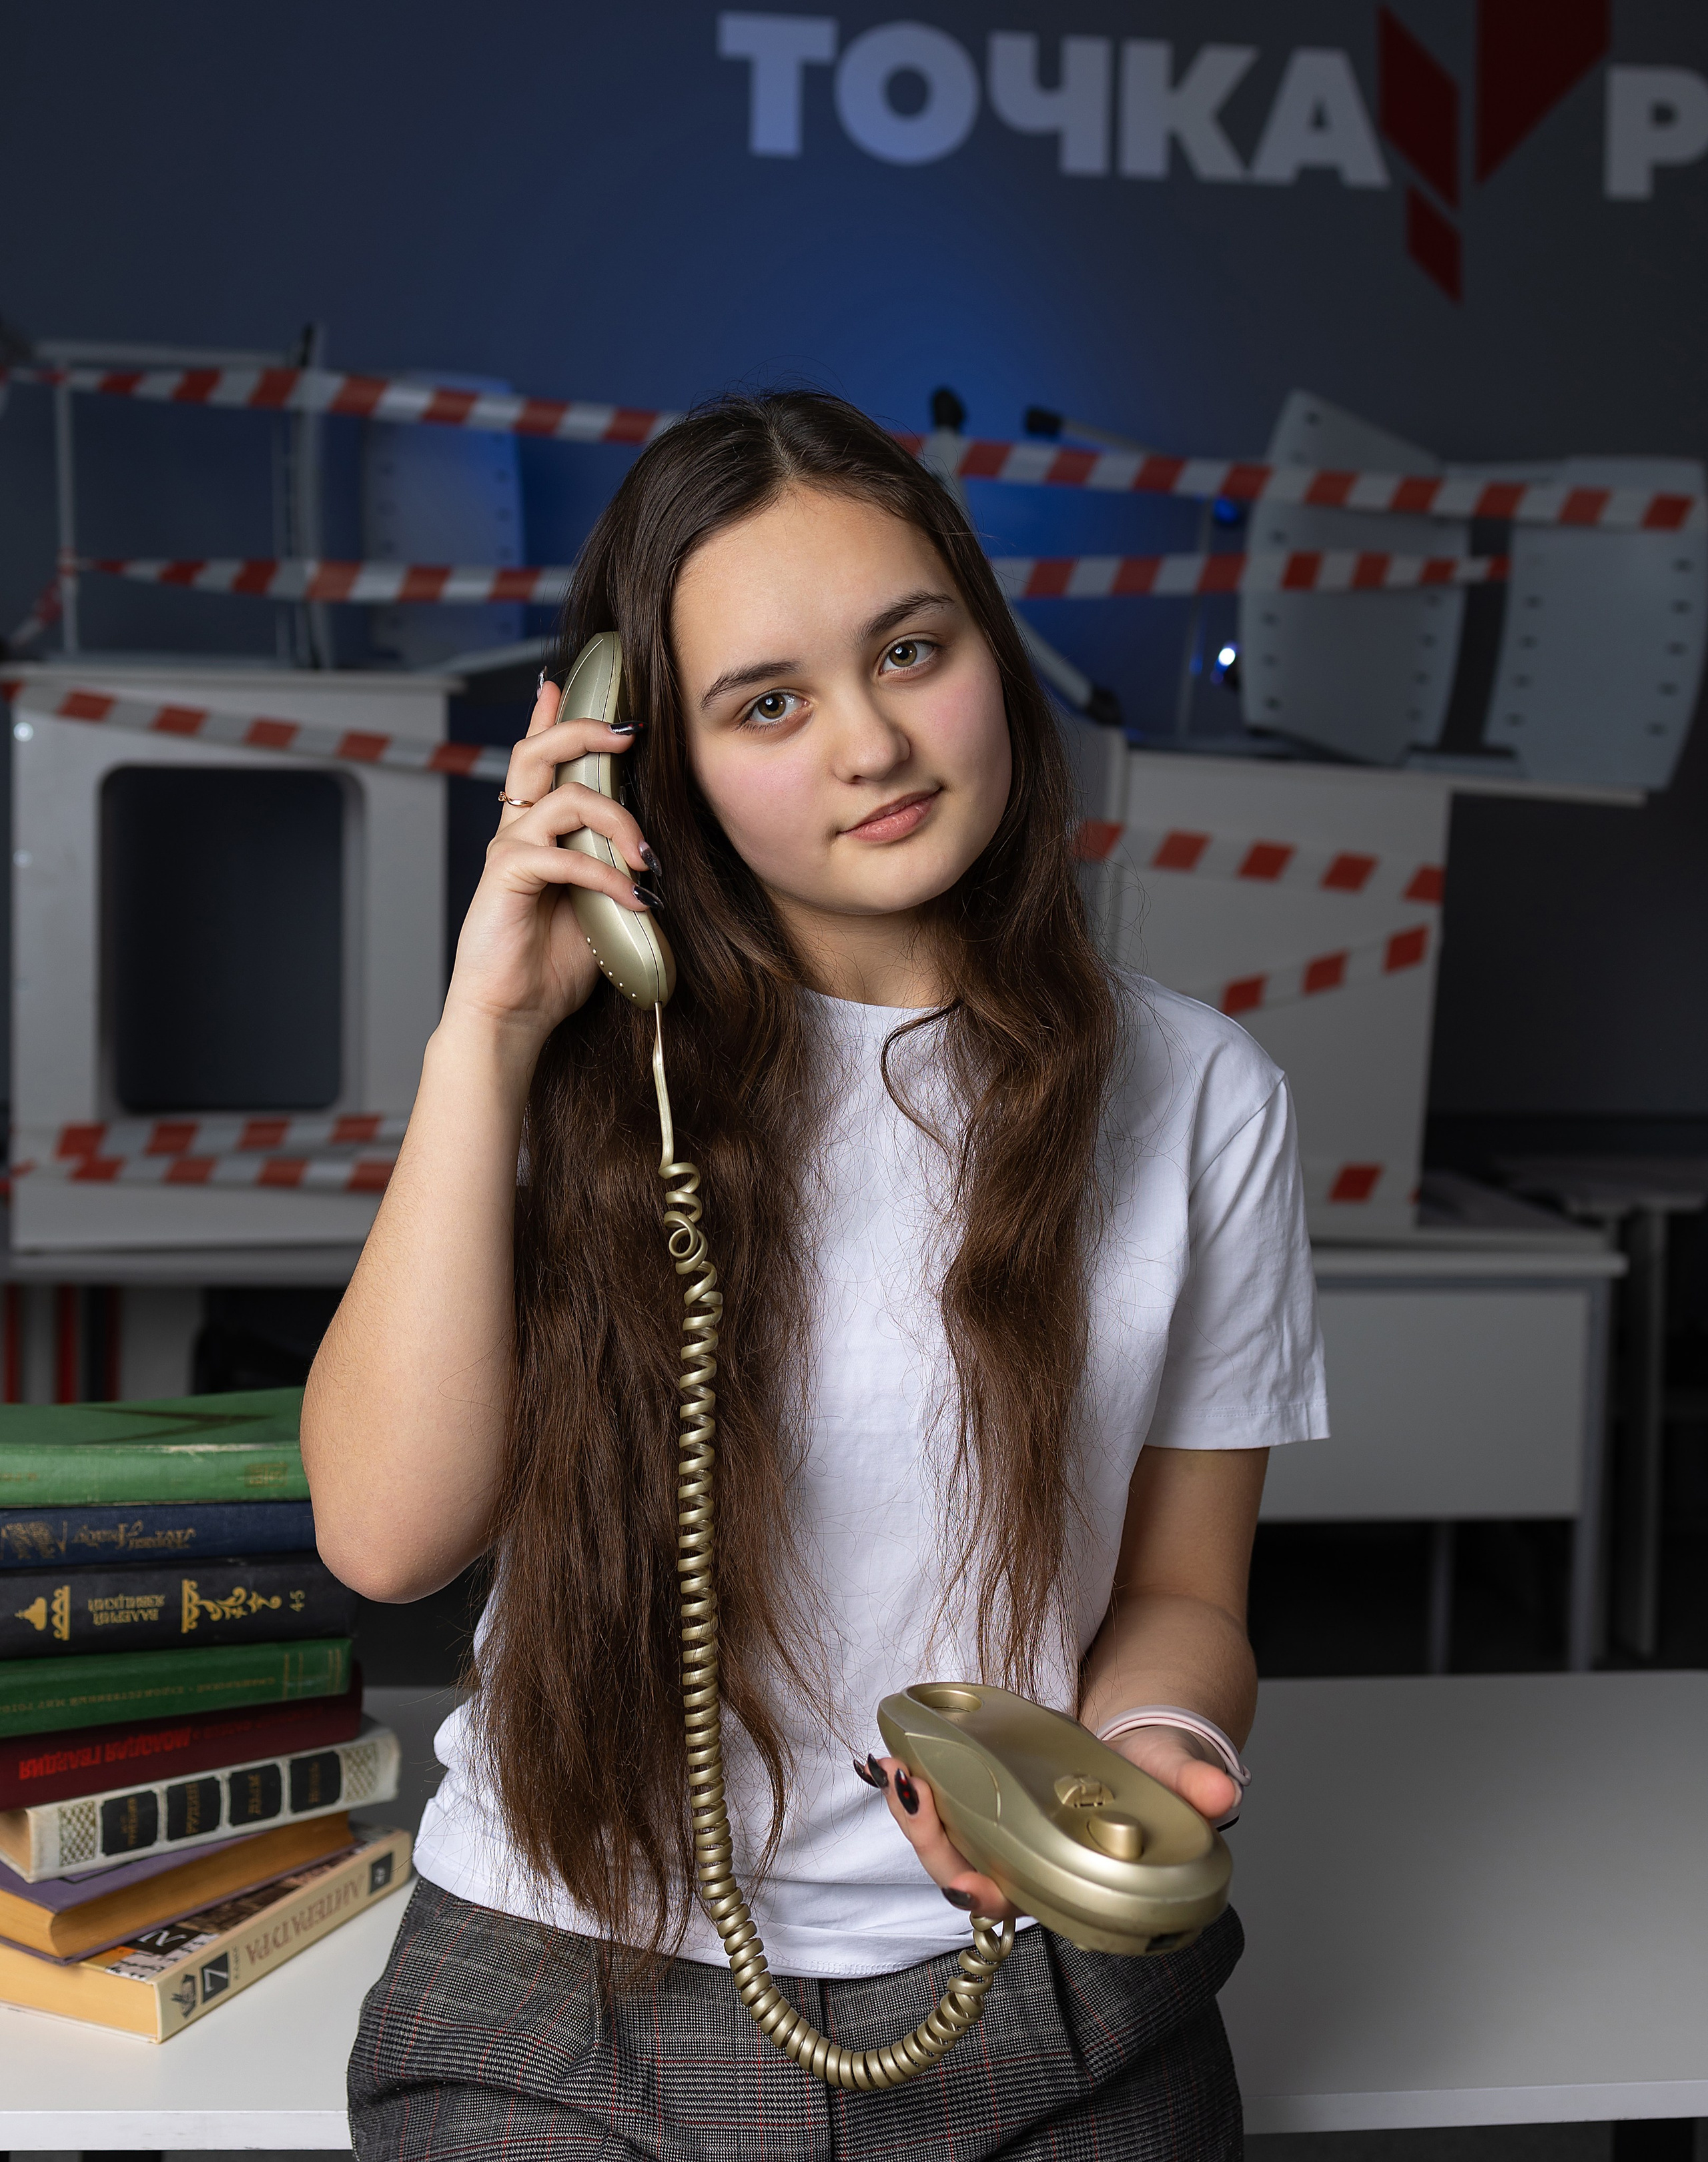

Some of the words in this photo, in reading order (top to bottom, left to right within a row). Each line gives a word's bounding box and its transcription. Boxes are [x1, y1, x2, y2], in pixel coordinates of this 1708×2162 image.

[718, 11, 1390, 189] ТОЧКА
[87, 1593, 165, 1612] ЯЗВИЦКИЙ
[92, 1609, 160, 1626] ВАЛЕРИЙ
[105, 1727, 191, 1762] МОЛОДАЯ
[19, 1746, 101, 1779] ГВАРДИЯ
[244, 1872, 365, 1965] ЛИТЕРАТУРА
[203, 1968, 229, 1993] 7
